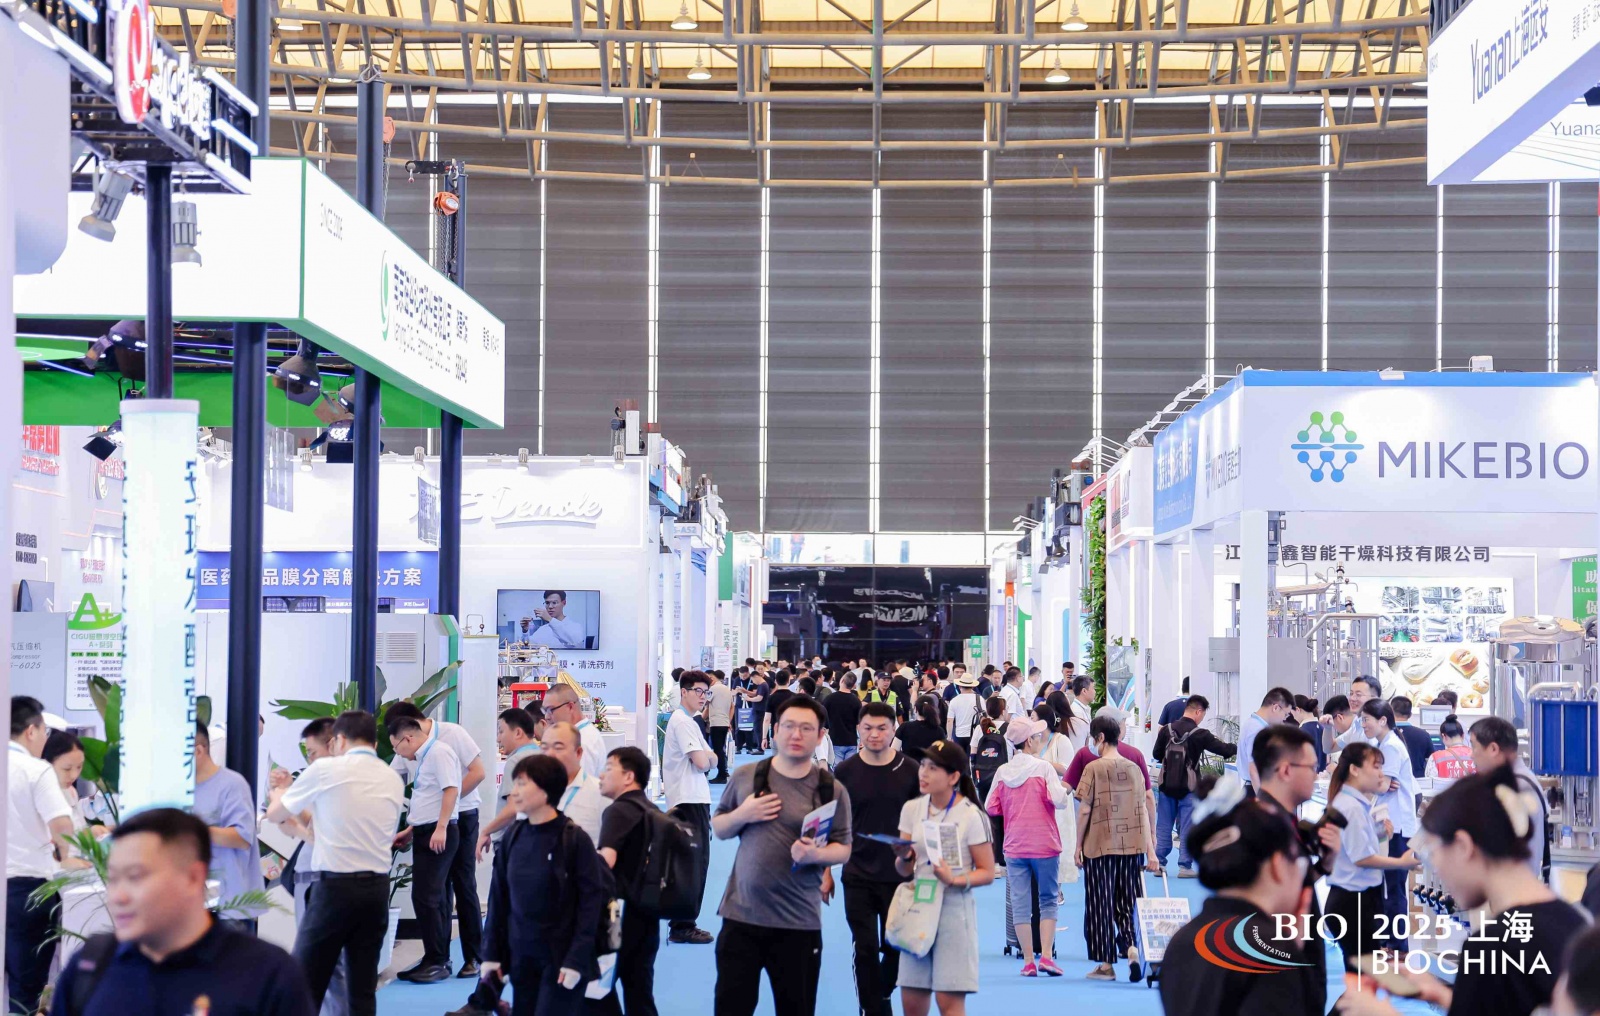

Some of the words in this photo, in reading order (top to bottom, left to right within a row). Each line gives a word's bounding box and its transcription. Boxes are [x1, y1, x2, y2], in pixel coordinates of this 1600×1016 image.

[1470, 29, 1511, 104] Yuanan
[1378, 441, 1590, 480] MIKEBIO
[491, 485, 603, 523] Demole
[1225, 544, 1490, 562] 江鑫智能干燥科技有限公司
[200, 567, 422, 586] 医药品膜分离解方案
[577, 681, 607, 689] 式膜元件
